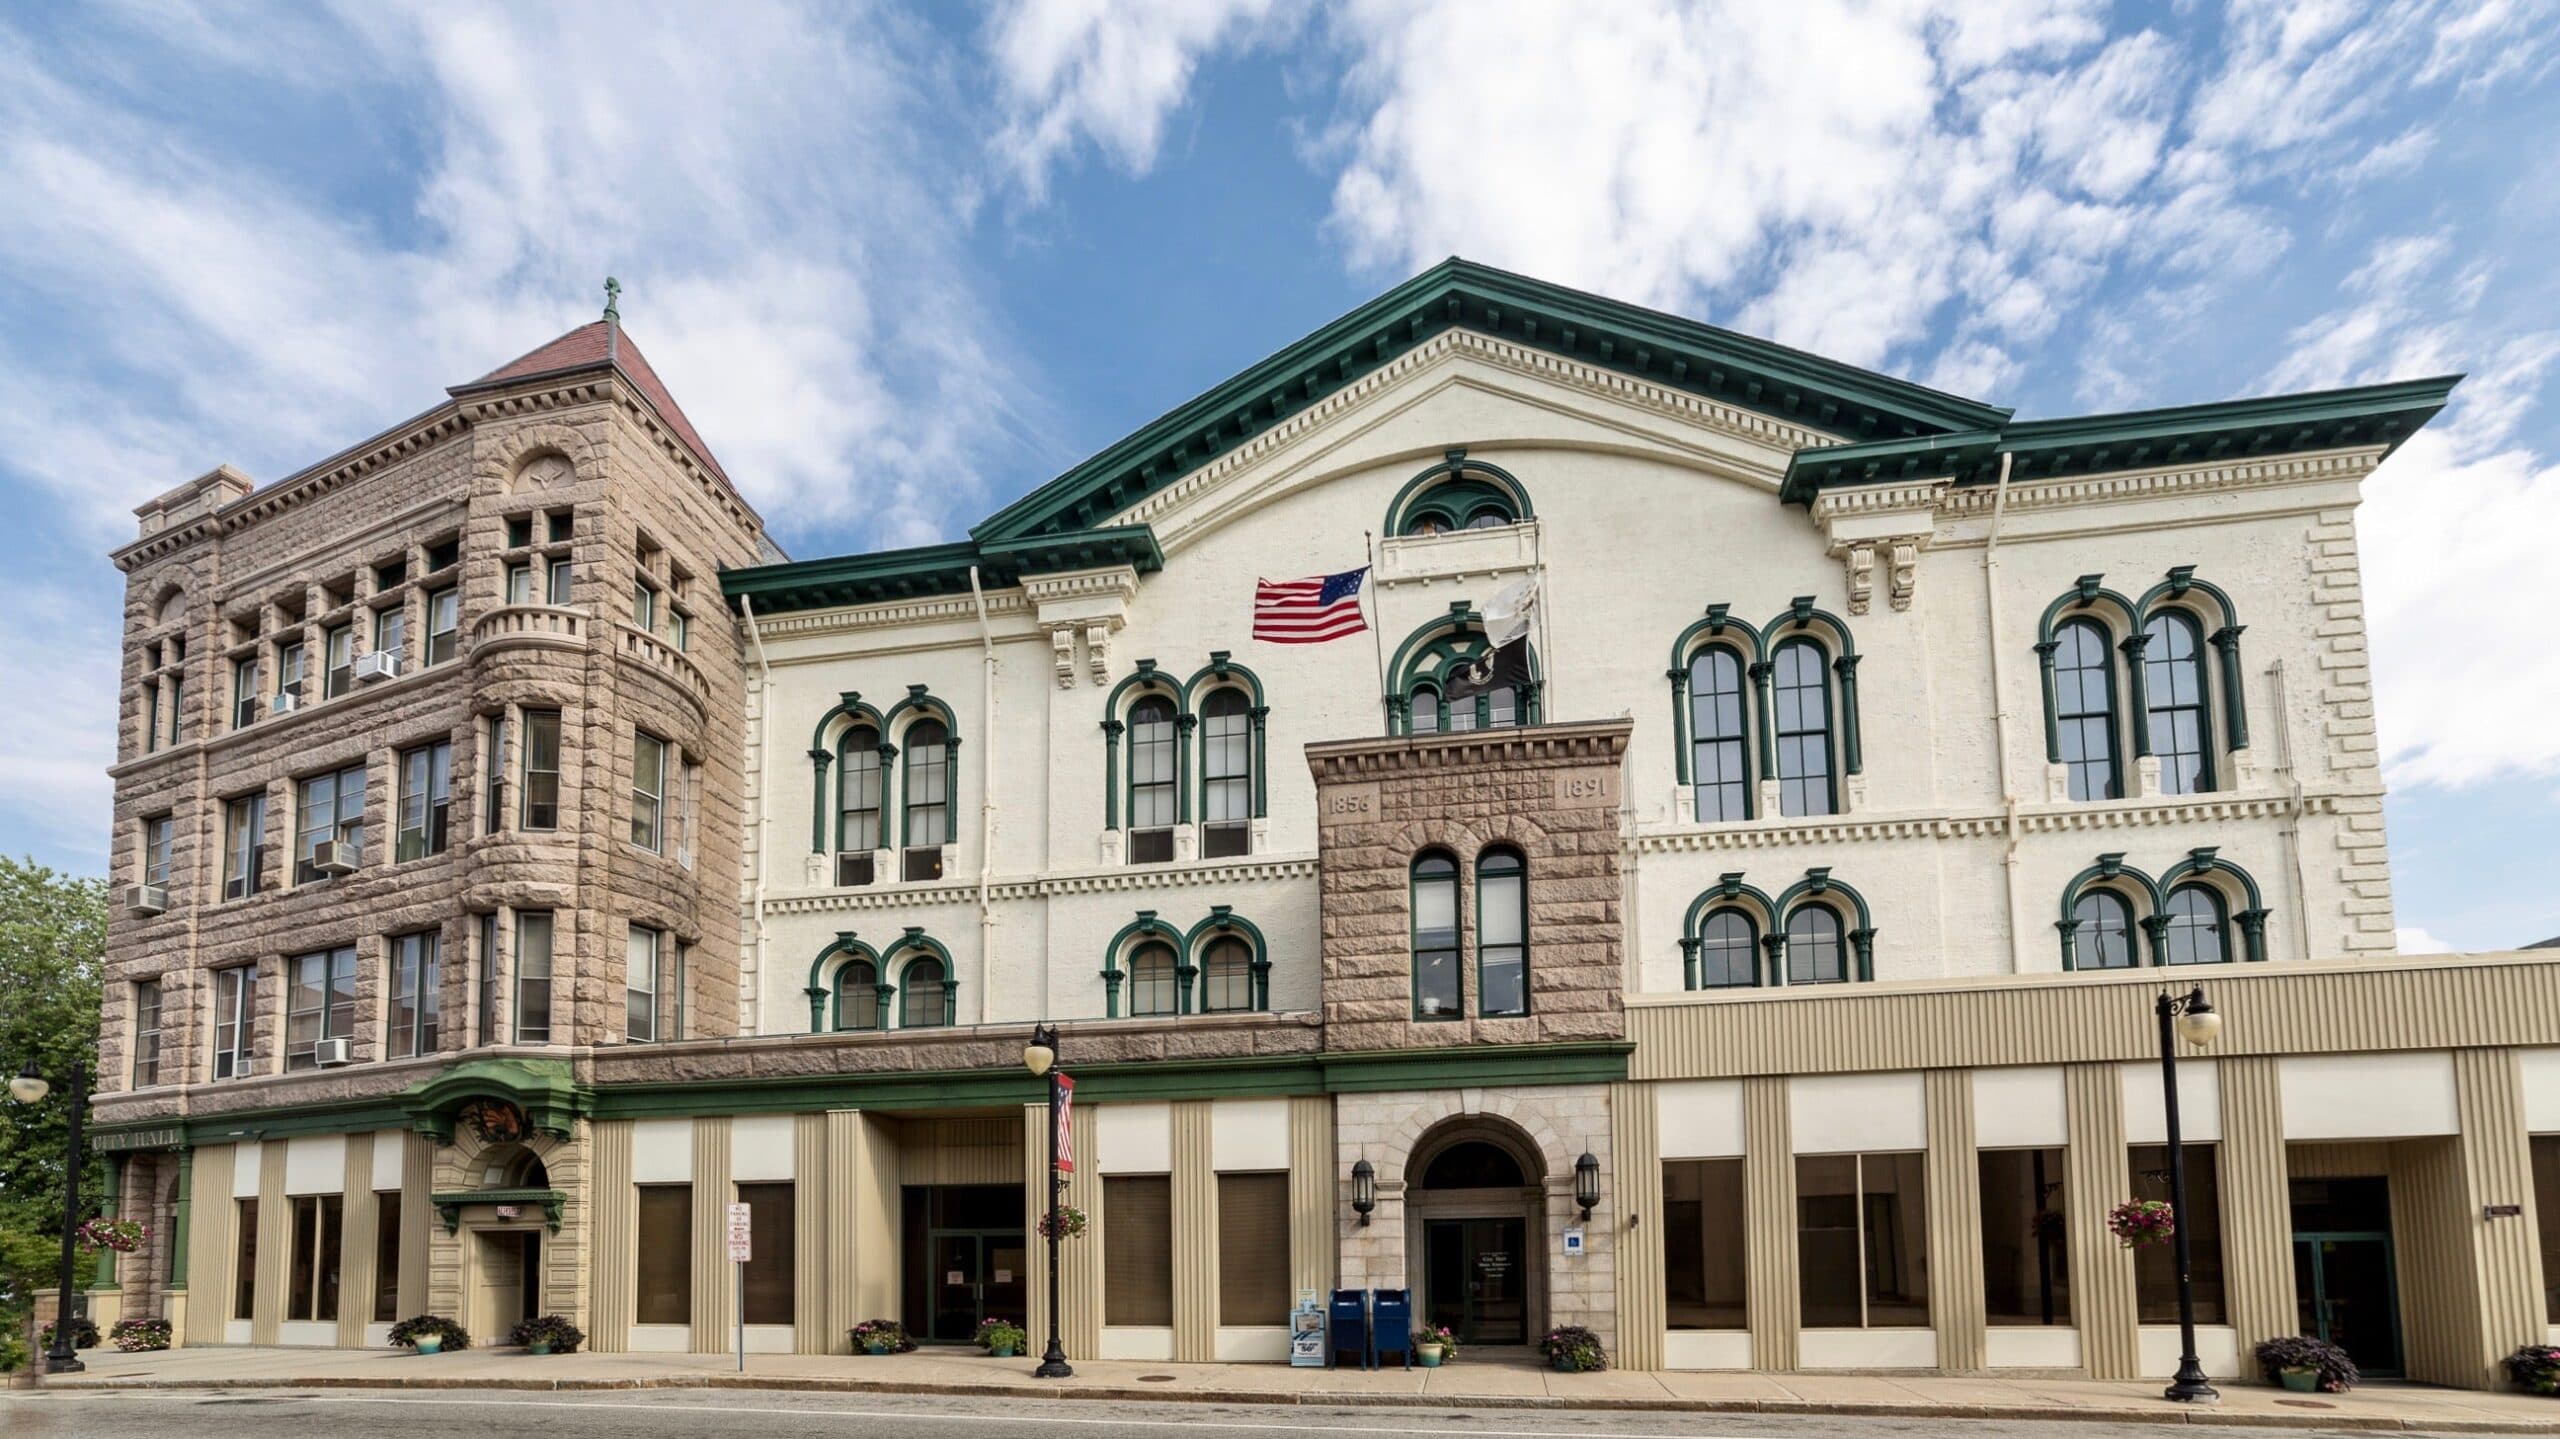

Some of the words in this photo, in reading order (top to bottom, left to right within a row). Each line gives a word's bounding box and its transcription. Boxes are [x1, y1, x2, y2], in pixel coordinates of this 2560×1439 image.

[1563, 777, 1605, 798] 1891
[1329, 794, 1371, 815] 1856
[93, 1134, 128, 1150] CITY
[135, 1130, 178, 1146] HALL
